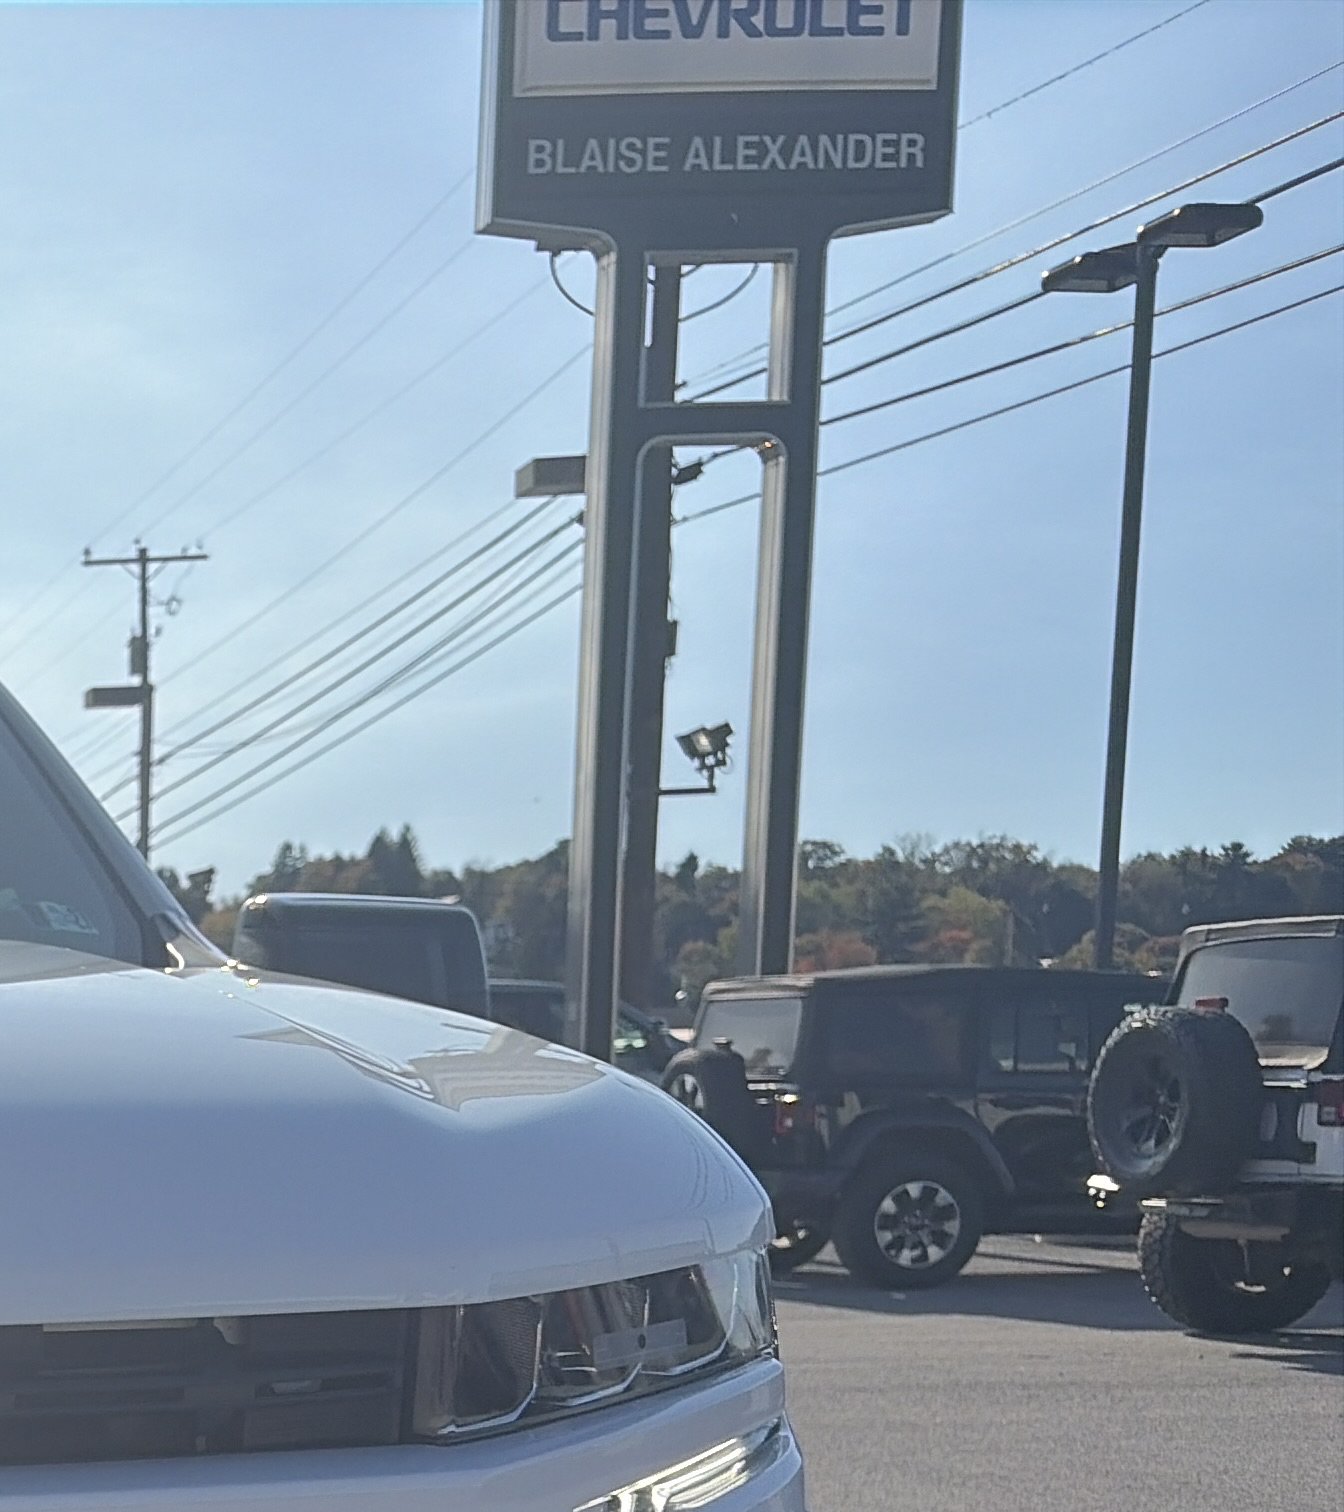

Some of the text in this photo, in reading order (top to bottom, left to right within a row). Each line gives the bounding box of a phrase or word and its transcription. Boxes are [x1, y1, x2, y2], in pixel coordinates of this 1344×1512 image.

[546, 0, 911, 42] CHEVROLET
[526, 132, 926, 175] BLAISE ALEXANDER
